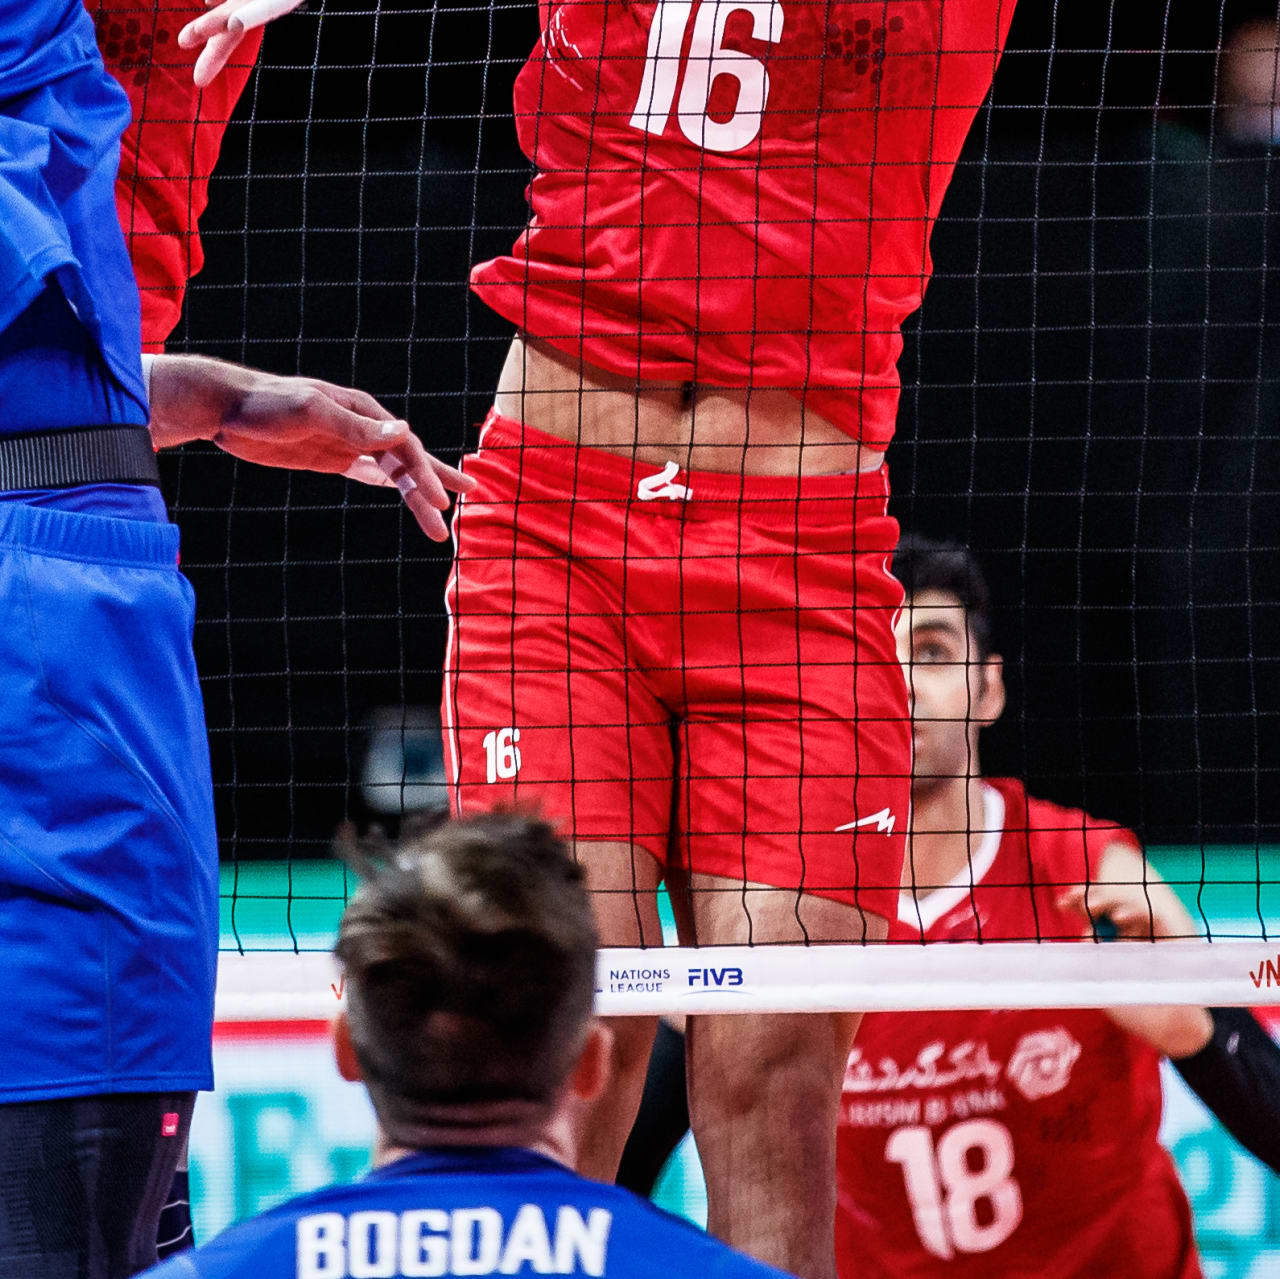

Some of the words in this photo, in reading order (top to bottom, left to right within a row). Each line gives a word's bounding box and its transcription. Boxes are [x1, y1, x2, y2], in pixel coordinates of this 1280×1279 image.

[482, 727, 523, 785] 16
[609, 968, 671, 980] NATIONS
[609, 982, 664, 994] LEAGUE
[687, 967, 744, 988] FIVB
[884, 1119, 1022, 1261] 18
[296, 1206, 612, 1279] BOGDAN
